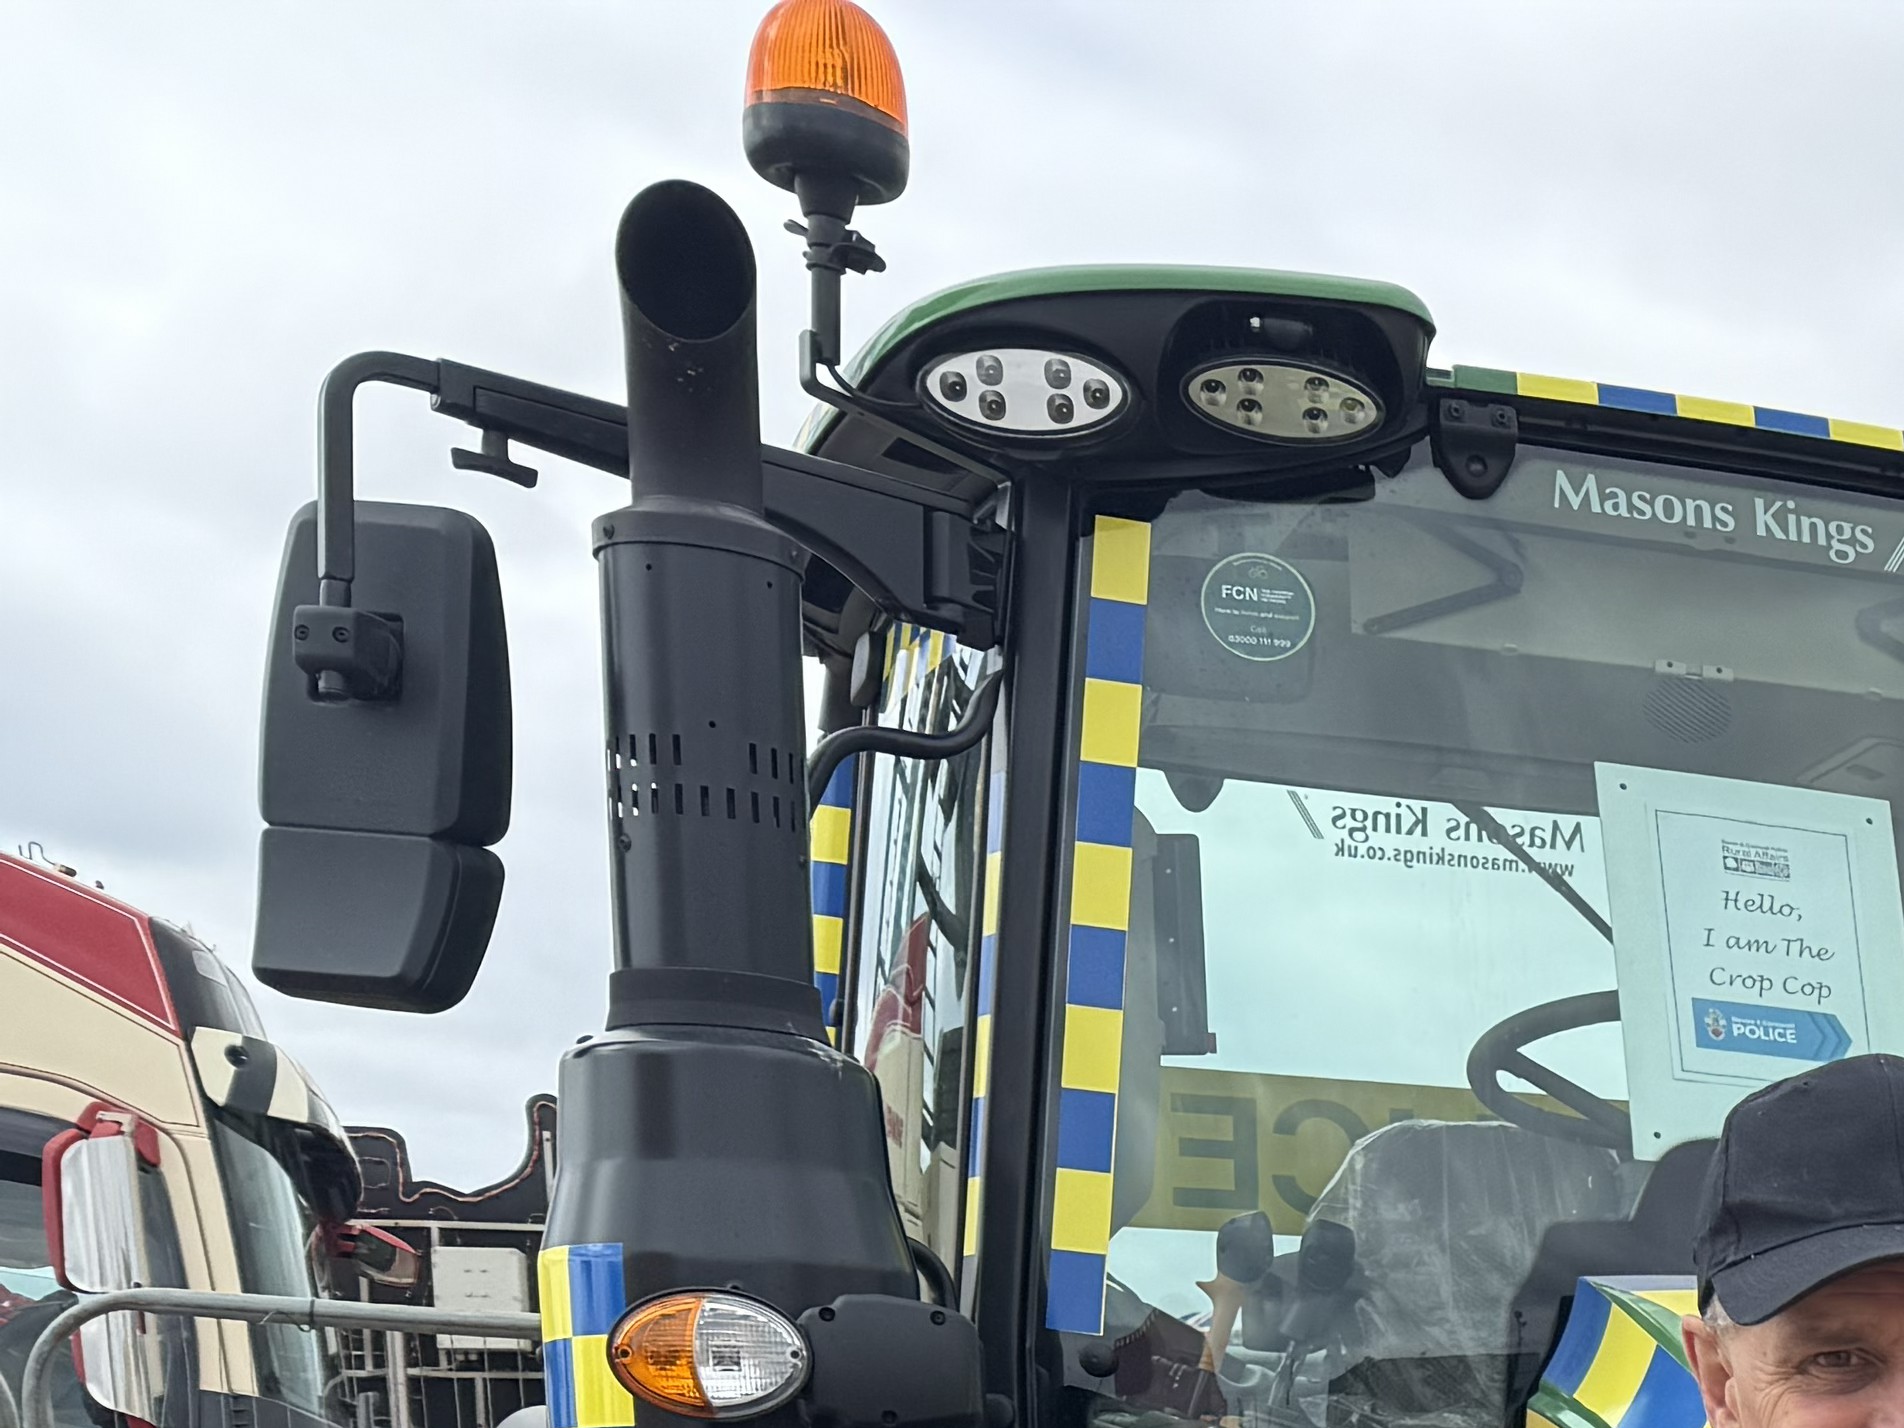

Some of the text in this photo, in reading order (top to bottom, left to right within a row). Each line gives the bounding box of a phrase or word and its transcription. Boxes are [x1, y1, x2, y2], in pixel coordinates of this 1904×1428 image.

[1554, 470, 1875, 564] Masons Kings
[1221, 585, 1258, 601] FCN
[1721, 890, 1802, 921] Hello,
[1703, 928, 1835, 961] I am The
[1709, 967, 1832, 1005] Crop Cop
[1732, 1025, 1797, 1044] POLICE
